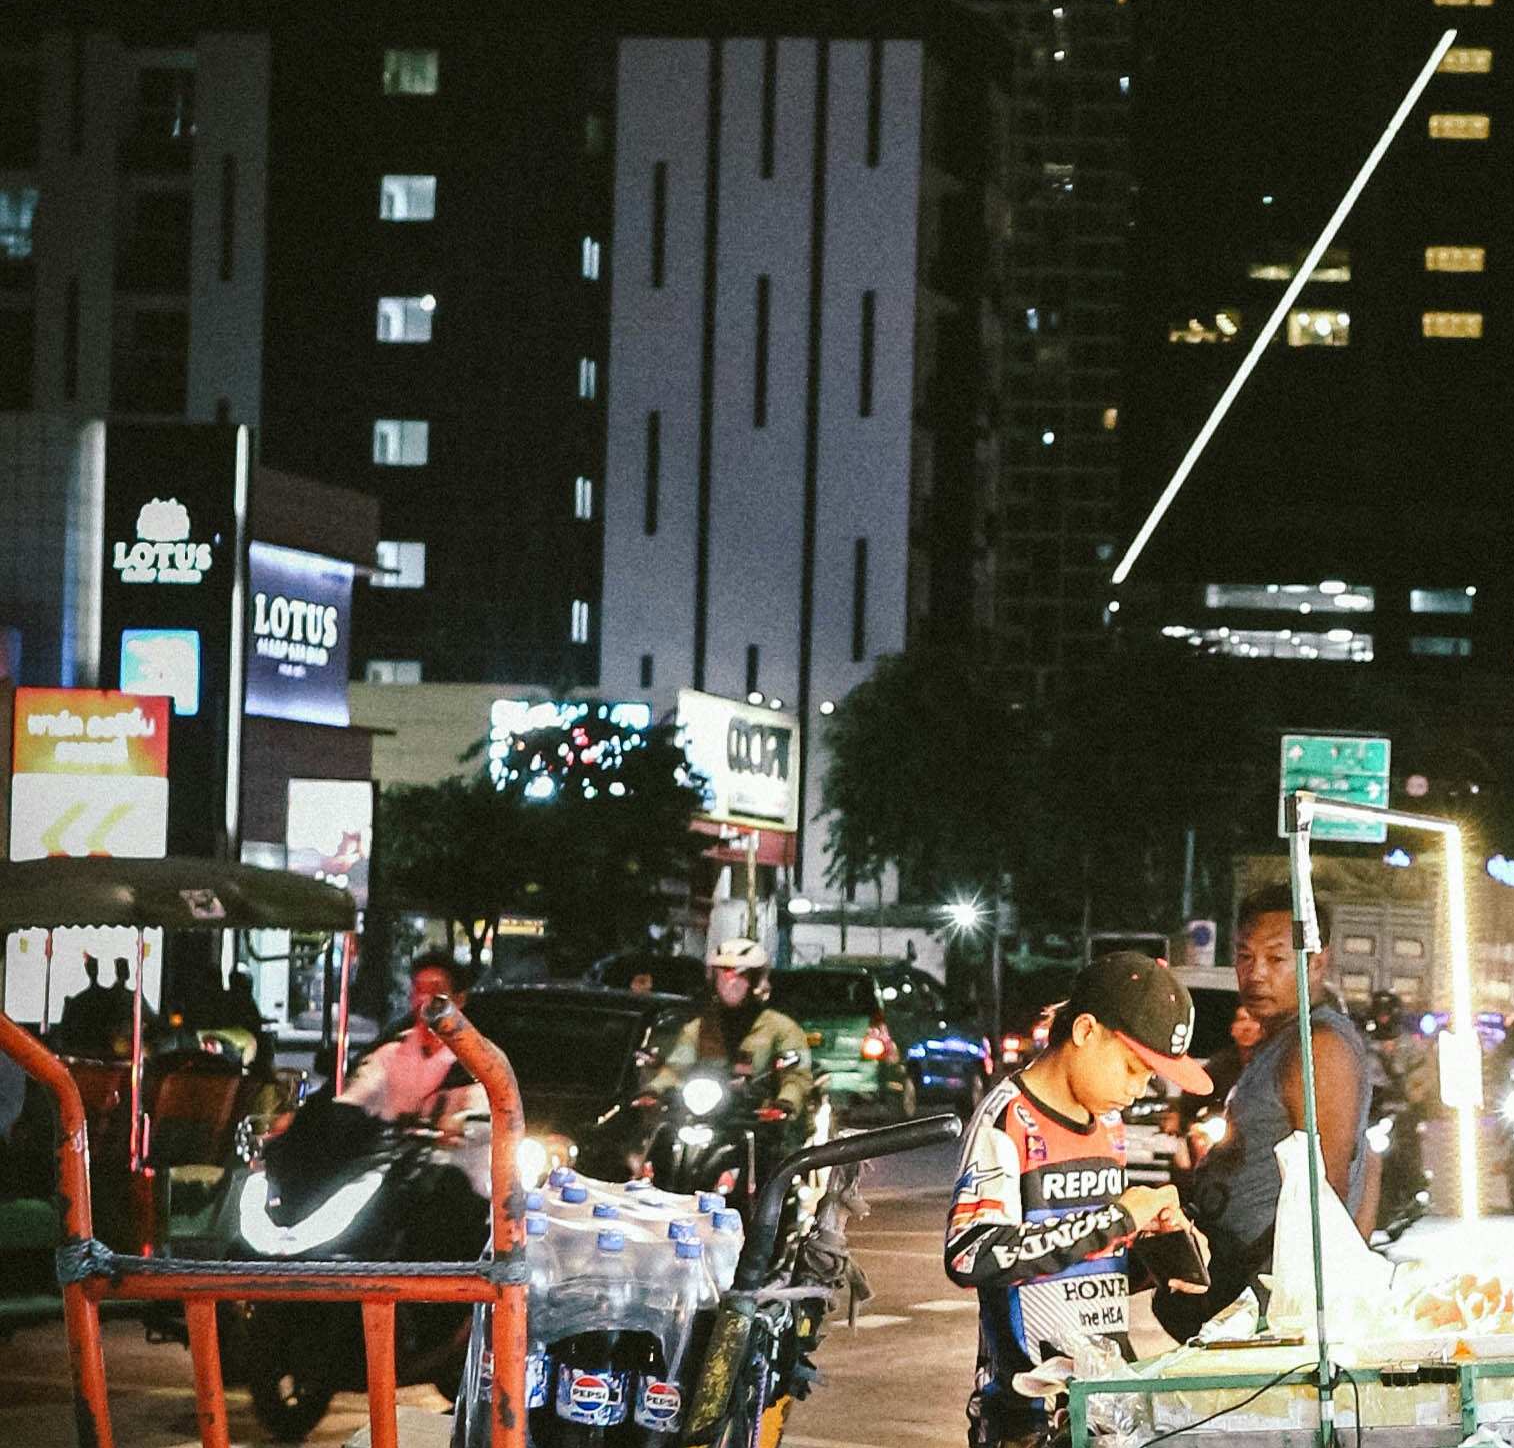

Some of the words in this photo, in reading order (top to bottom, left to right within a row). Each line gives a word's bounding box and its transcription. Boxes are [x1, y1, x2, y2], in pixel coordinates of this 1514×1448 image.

[113, 542, 212, 571] LOTUS
[253, 592, 338, 649] LOTUS
[572, 1387, 606, 1399] PEPSI
[645, 1394, 679, 1408] PEPSI
